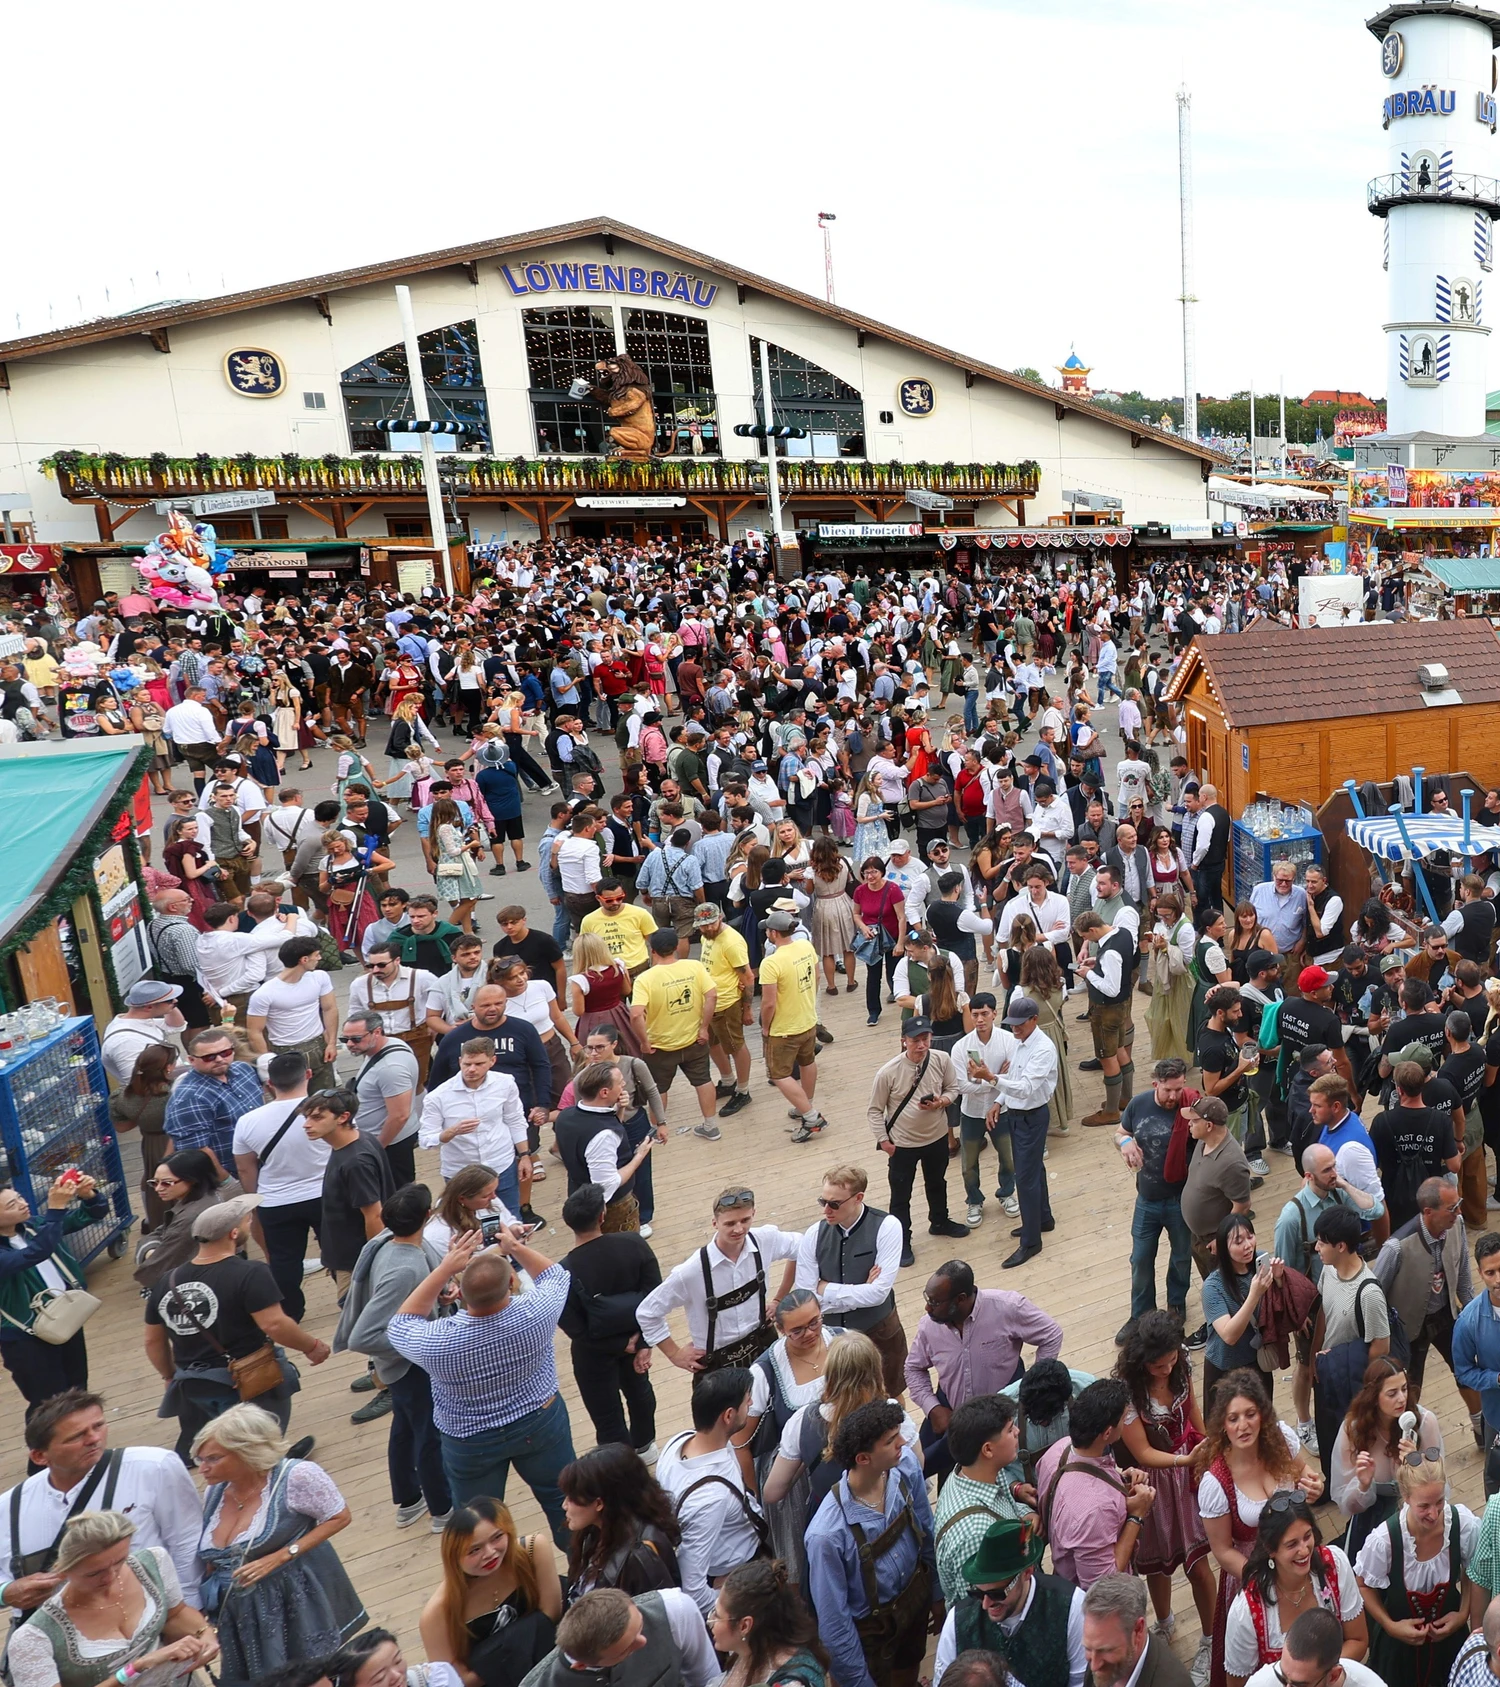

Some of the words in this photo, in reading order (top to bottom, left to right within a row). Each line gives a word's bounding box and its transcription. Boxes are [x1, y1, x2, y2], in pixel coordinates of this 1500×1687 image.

[500, 260, 718, 308] LÖWENBRÄU
[820, 524, 856, 536] Wies'n
[861, 524, 906, 536] Brotzeit
[1171, 524, 1210, 533] Tabakwaren
[1282, 1012, 1297, 1023] LAST
[1297, 1019, 1310, 1030] GAS
[1282, 1020, 1309, 1038] STANDING
[1430, 1031, 1444, 1041] GAS
[1463, 1070, 1475, 1085] LAST
[1475, 1063, 1486, 1075] GAS
[1436, 1099, 1452, 1111] GAS
